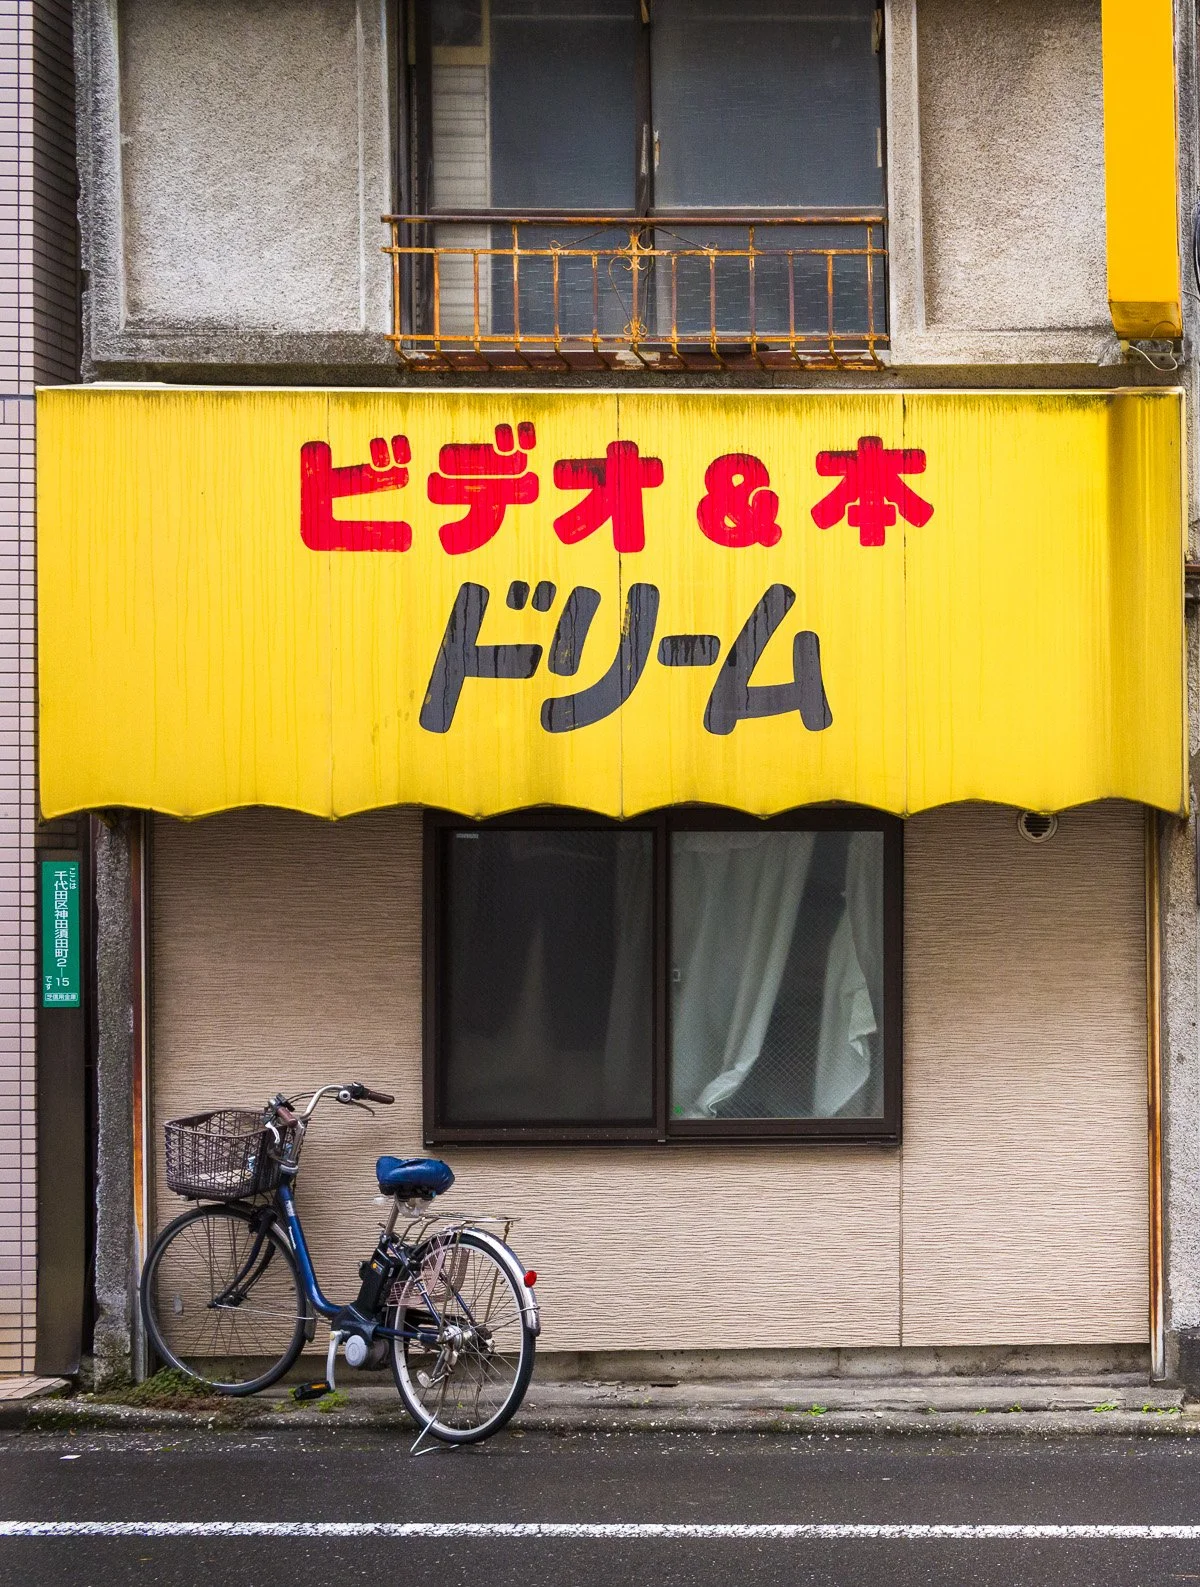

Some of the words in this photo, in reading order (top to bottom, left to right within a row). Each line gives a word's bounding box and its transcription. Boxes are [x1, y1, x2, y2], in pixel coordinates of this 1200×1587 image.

[418, 580, 834, 736] ドリーム
[69, 867, 77, 890] ここは
[45, 975, 53, 991] です
